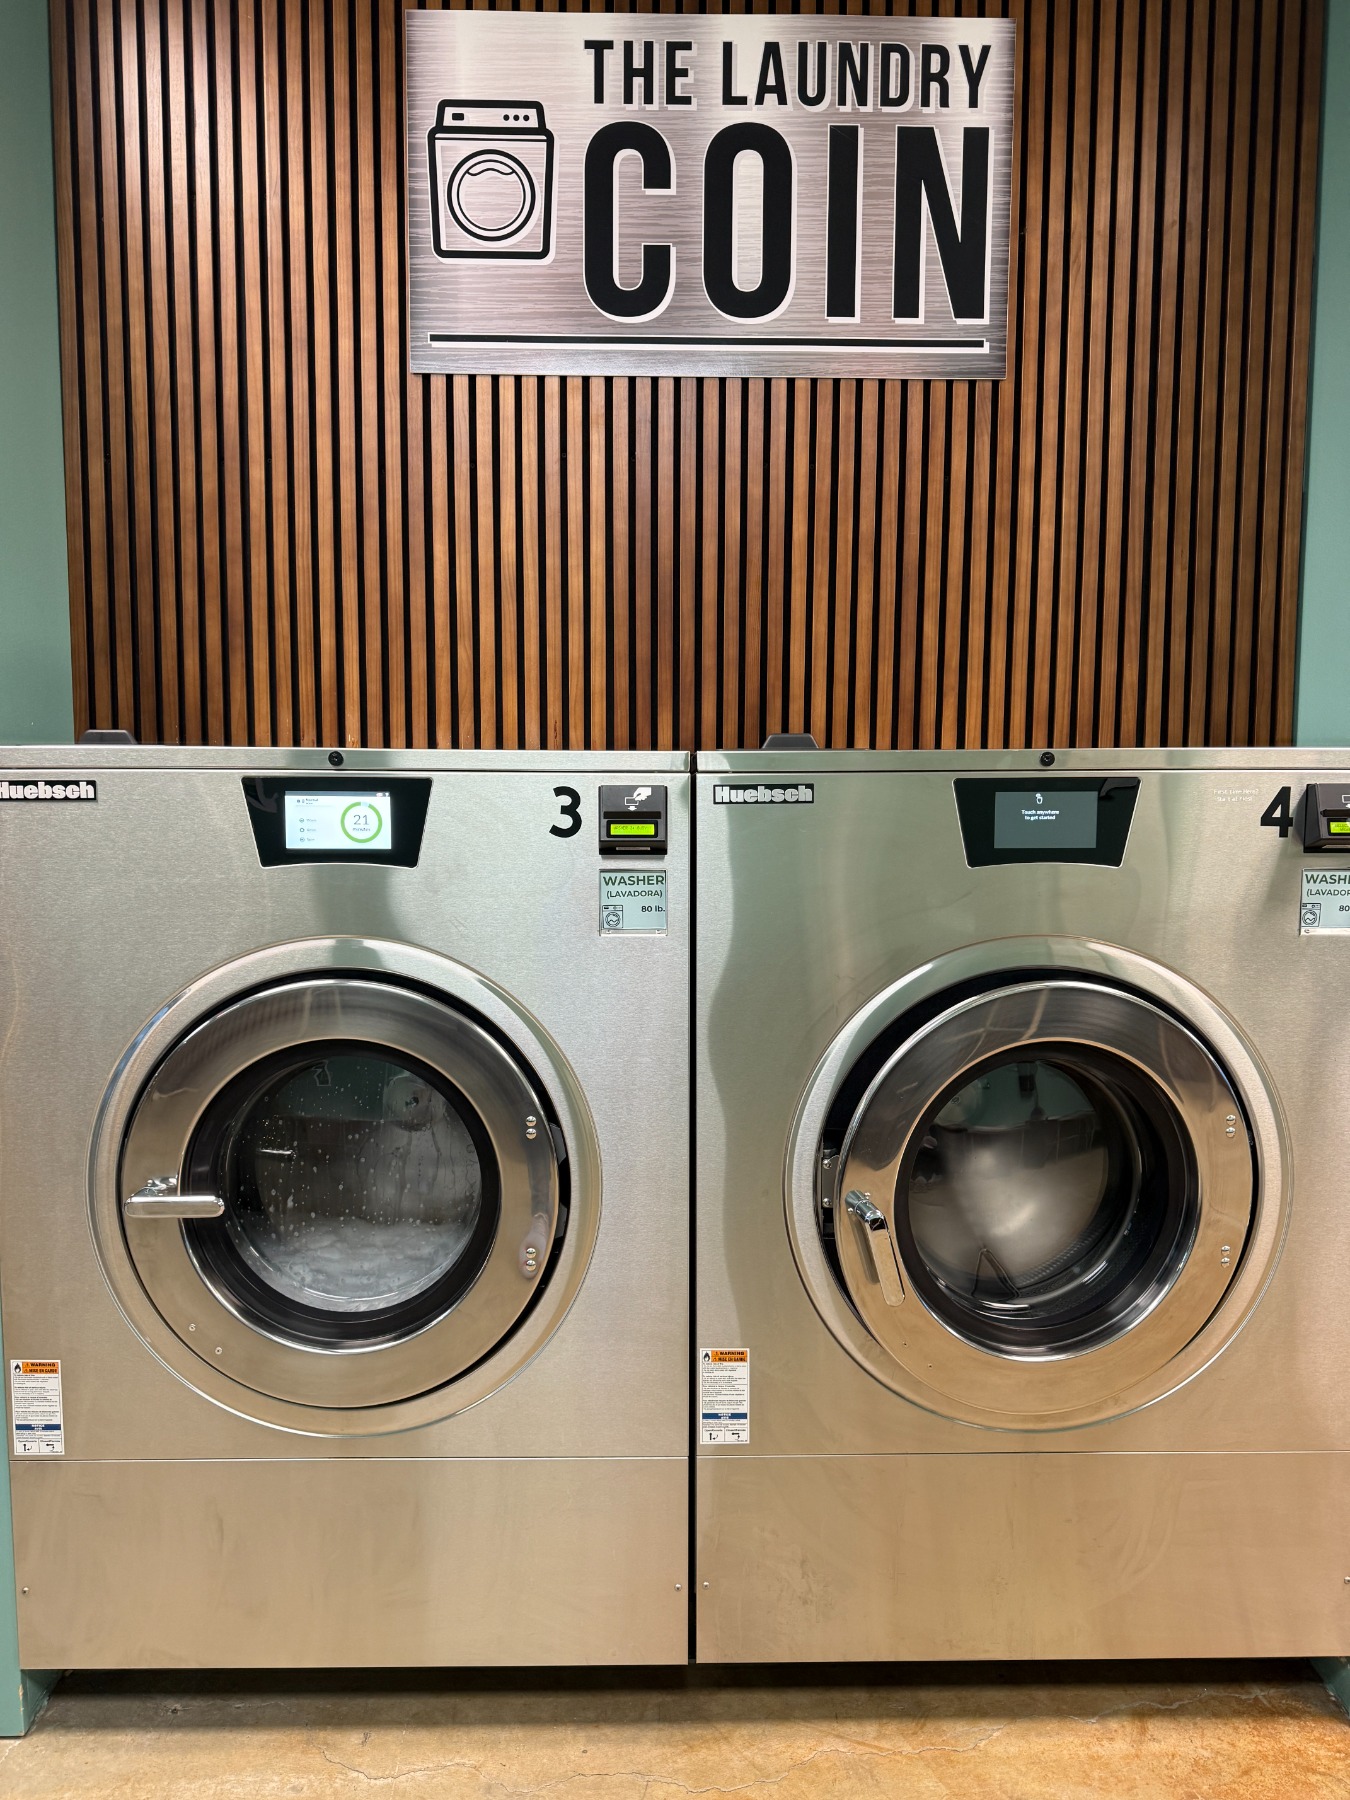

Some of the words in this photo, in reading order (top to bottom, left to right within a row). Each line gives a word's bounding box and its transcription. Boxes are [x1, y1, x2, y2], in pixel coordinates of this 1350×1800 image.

[584, 40, 693, 106] THE
[722, 41, 992, 109] LAUNDRY
[583, 121, 991, 321] COIN
[0, 781, 95, 799] Huebsch
[714, 785, 813, 802] Huebsch
[549, 785, 582, 838] 3
[1260, 786, 1294, 838] 4
[353, 814, 370, 826] 21
[603, 875, 665, 886] WASHER
[1305, 874, 1350, 885] WASH
[606, 889, 663, 899] (LAVADORA)
[641, 905, 653, 913] 80
[1338, 904, 1350, 912] 80
